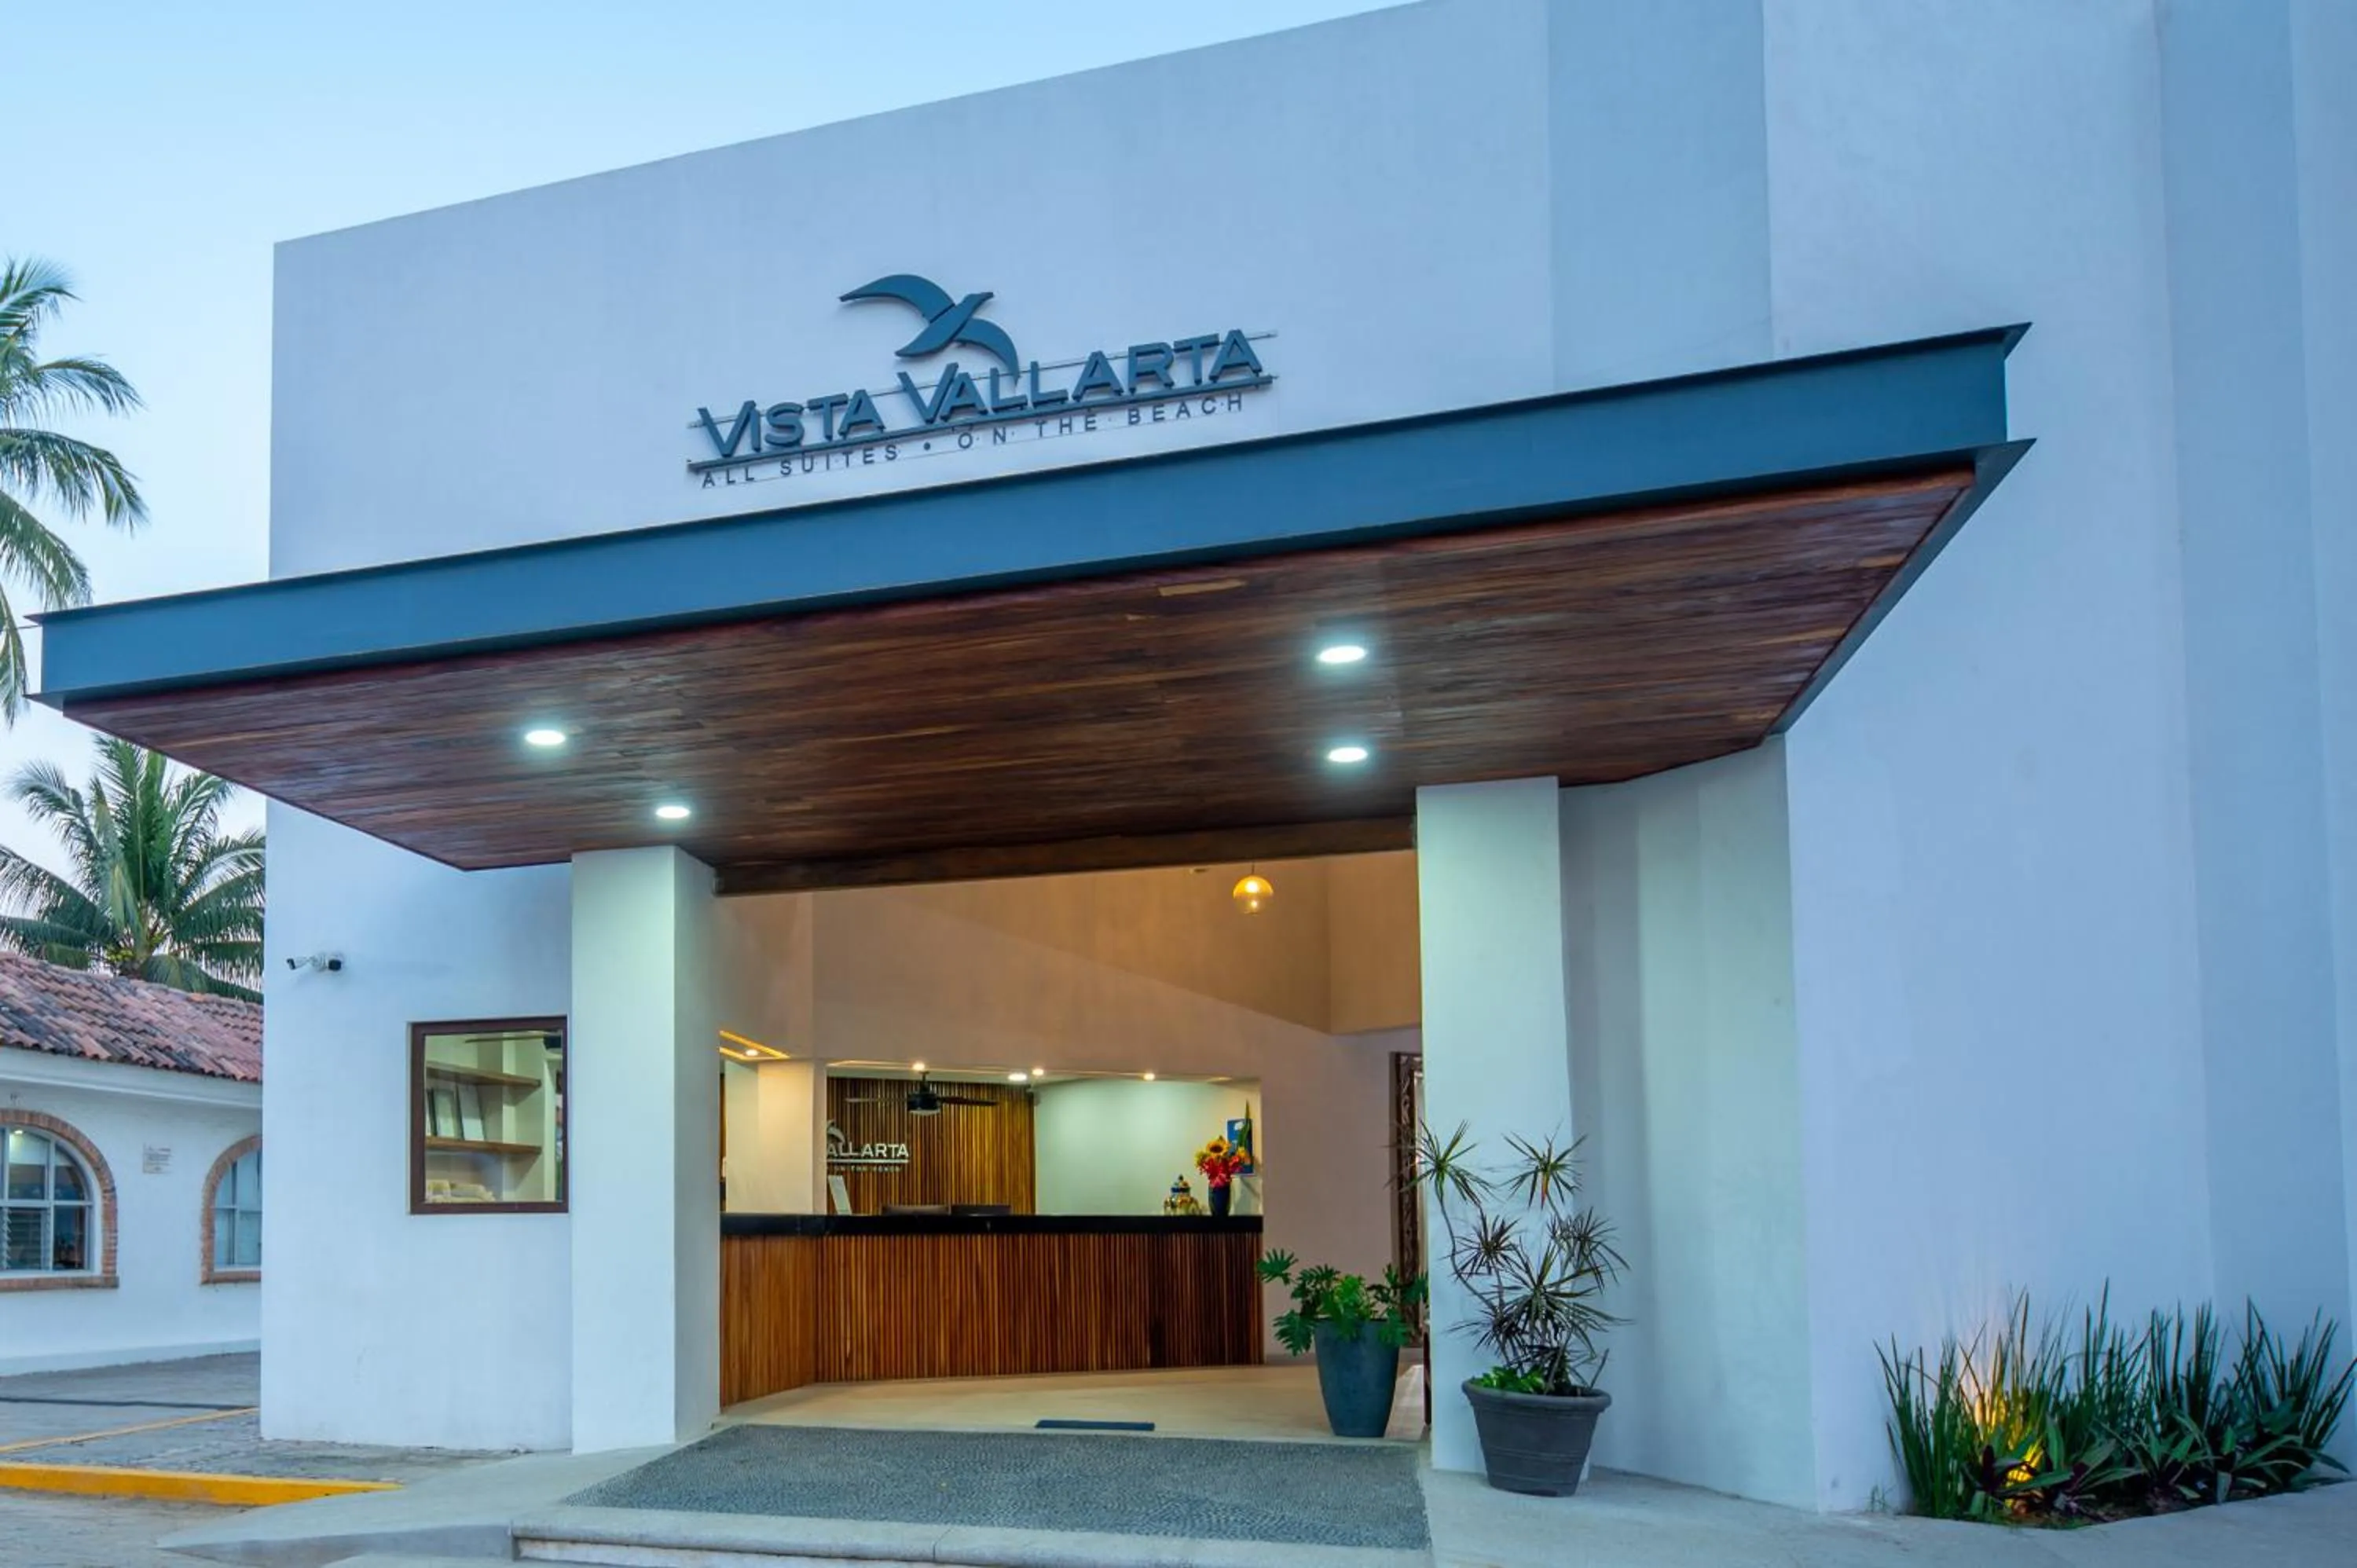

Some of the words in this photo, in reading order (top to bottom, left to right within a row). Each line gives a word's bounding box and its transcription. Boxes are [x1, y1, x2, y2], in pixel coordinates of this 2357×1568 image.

[698, 389, 885, 457] VISTA
[897, 328, 1263, 424] VALLARTA
[702, 469, 754, 488] ALL
[780, 443, 897, 475] SUITES
[958, 427, 1006, 449] ON
[1035, 413, 1097, 438] THE
[1128, 393, 1241, 425] BEACH
[827, 1141, 909, 1158] ALLARTA
